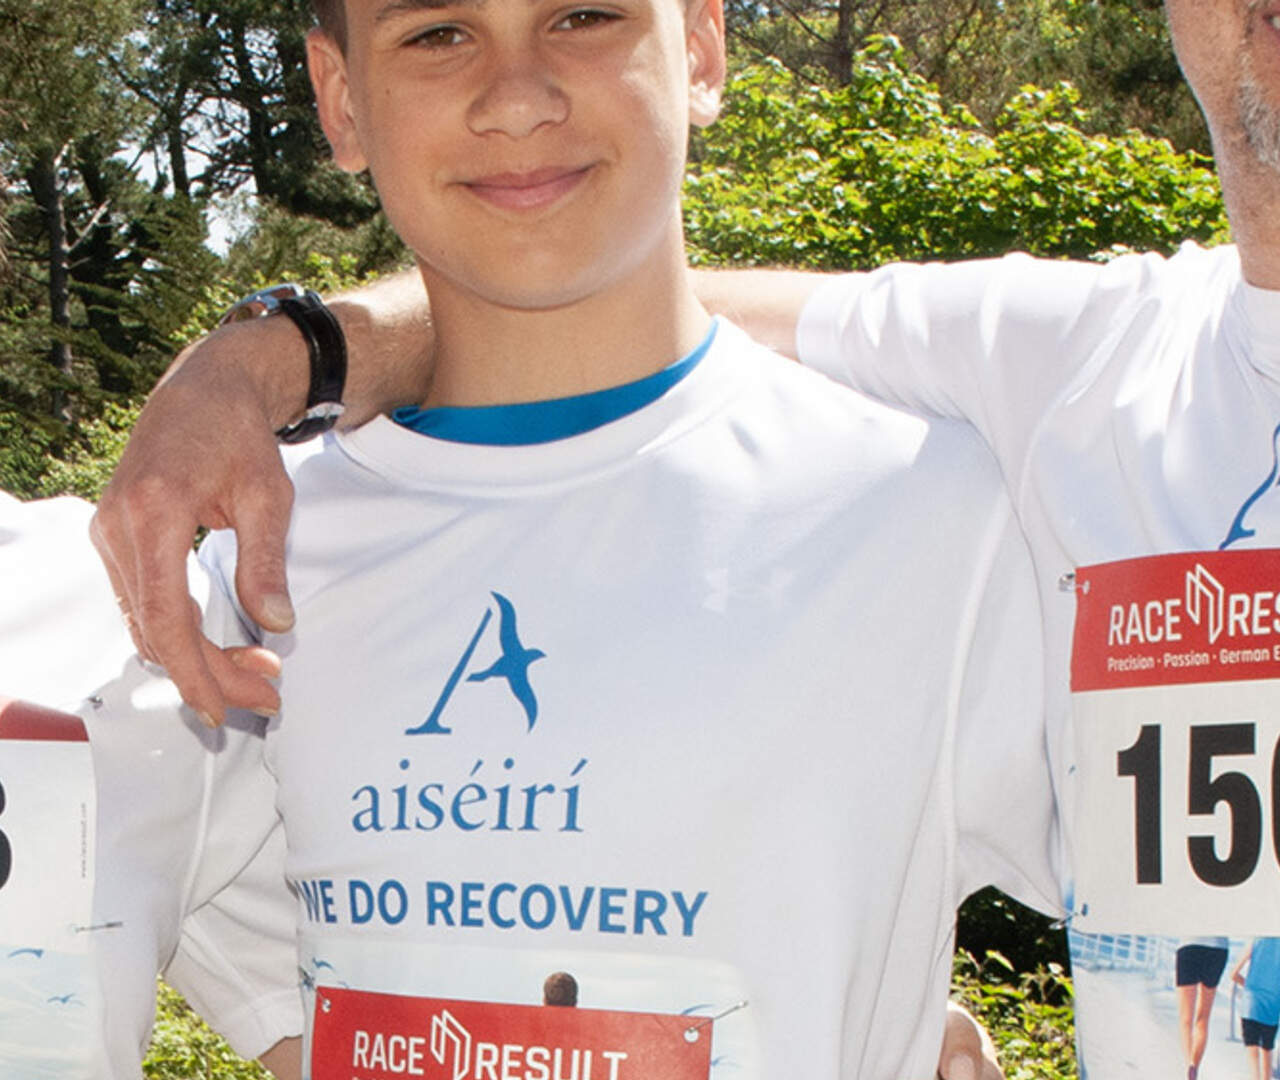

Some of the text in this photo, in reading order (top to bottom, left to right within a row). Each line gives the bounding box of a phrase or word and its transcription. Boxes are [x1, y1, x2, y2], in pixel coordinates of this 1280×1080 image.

[1108, 599, 1181, 645] RACE
[1107, 655, 1155, 672] Precision
[1163, 650, 1210, 668] Passion
[1220, 647, 1270, 665] German
[352, 758, 587, 832] aiséirí
[349, 880, 408, 924] DO
[427, 881, 707, 936] RECOVERY
[352, 1030, 426, 1076] RACE
